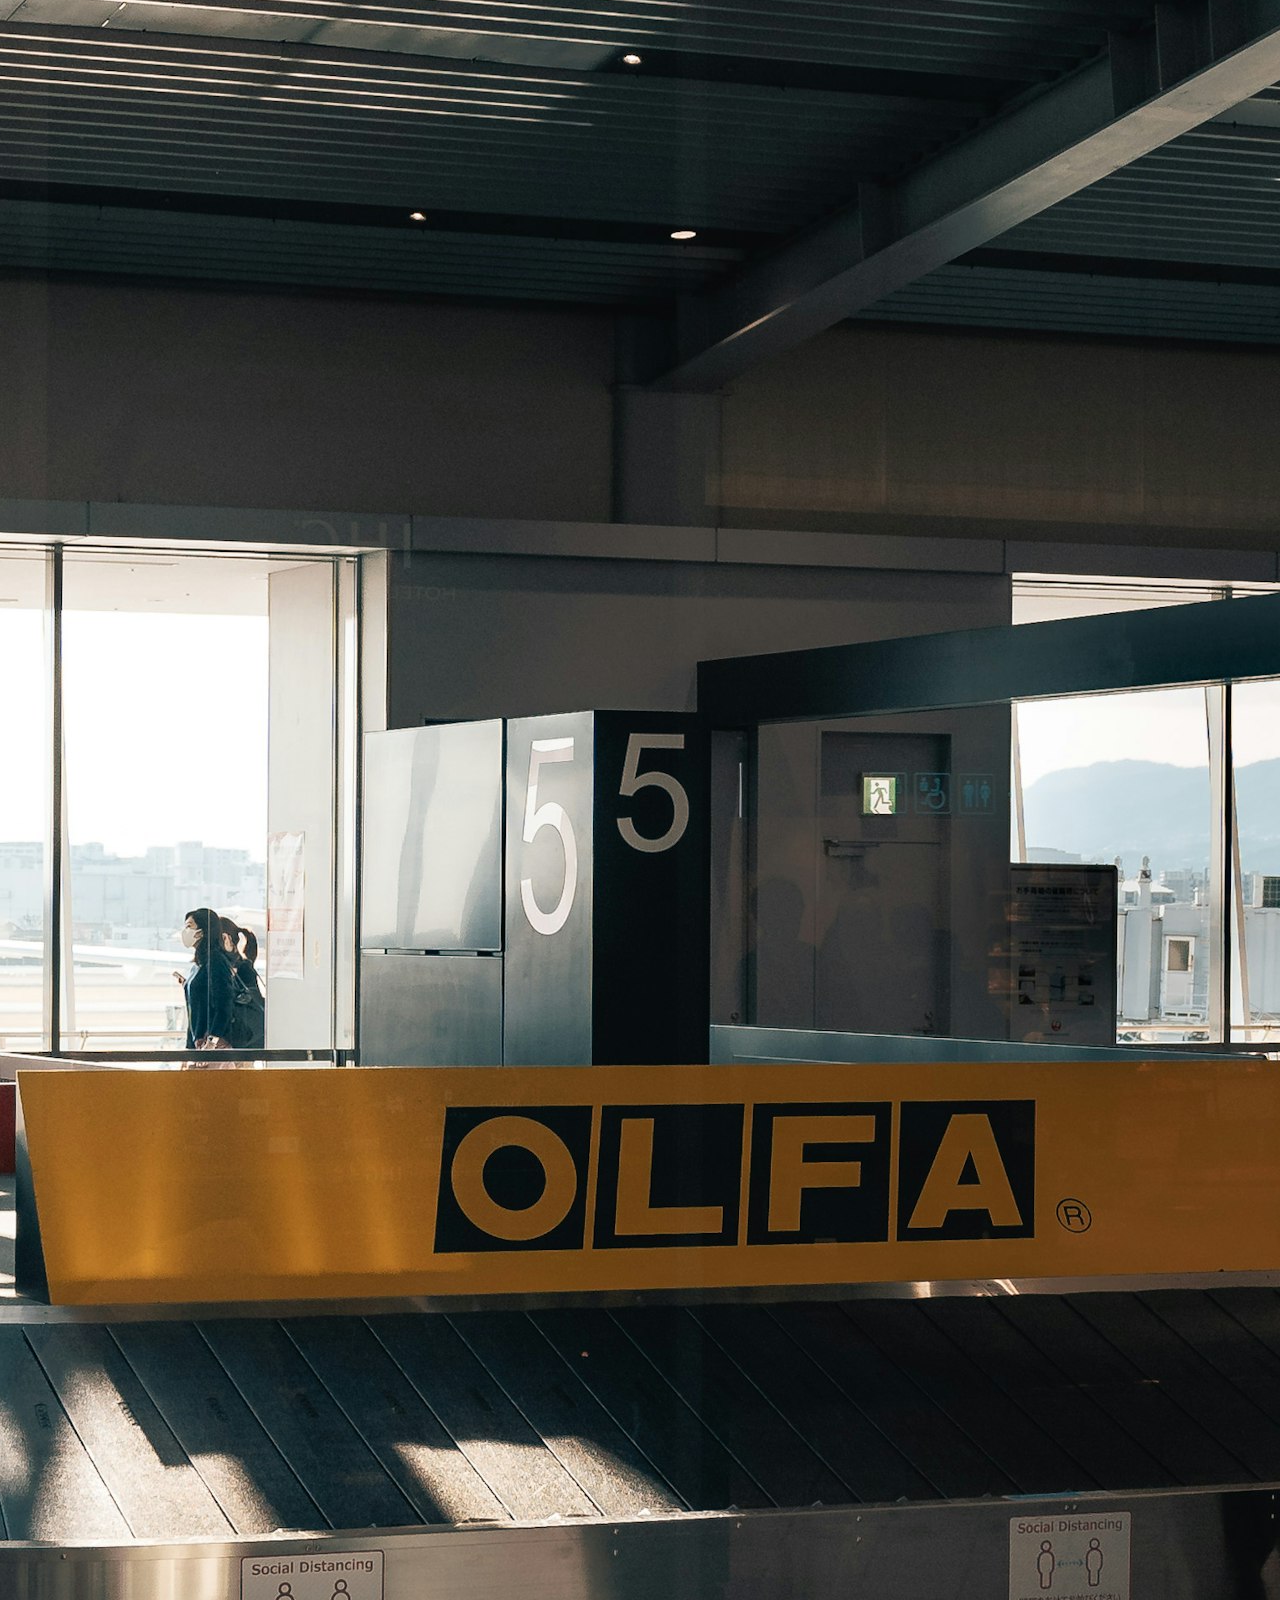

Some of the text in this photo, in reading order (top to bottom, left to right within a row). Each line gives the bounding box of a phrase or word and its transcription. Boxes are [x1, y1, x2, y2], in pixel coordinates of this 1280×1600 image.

[520, 736, 578, 936] 5
[616, 733, 690, 853] 5
[448, 1111, 1024, 1243] OLFA
[251, 1557, 374, 1576] Social Distancing
[1017, 1518, 1123, 1534] Social Distancing
